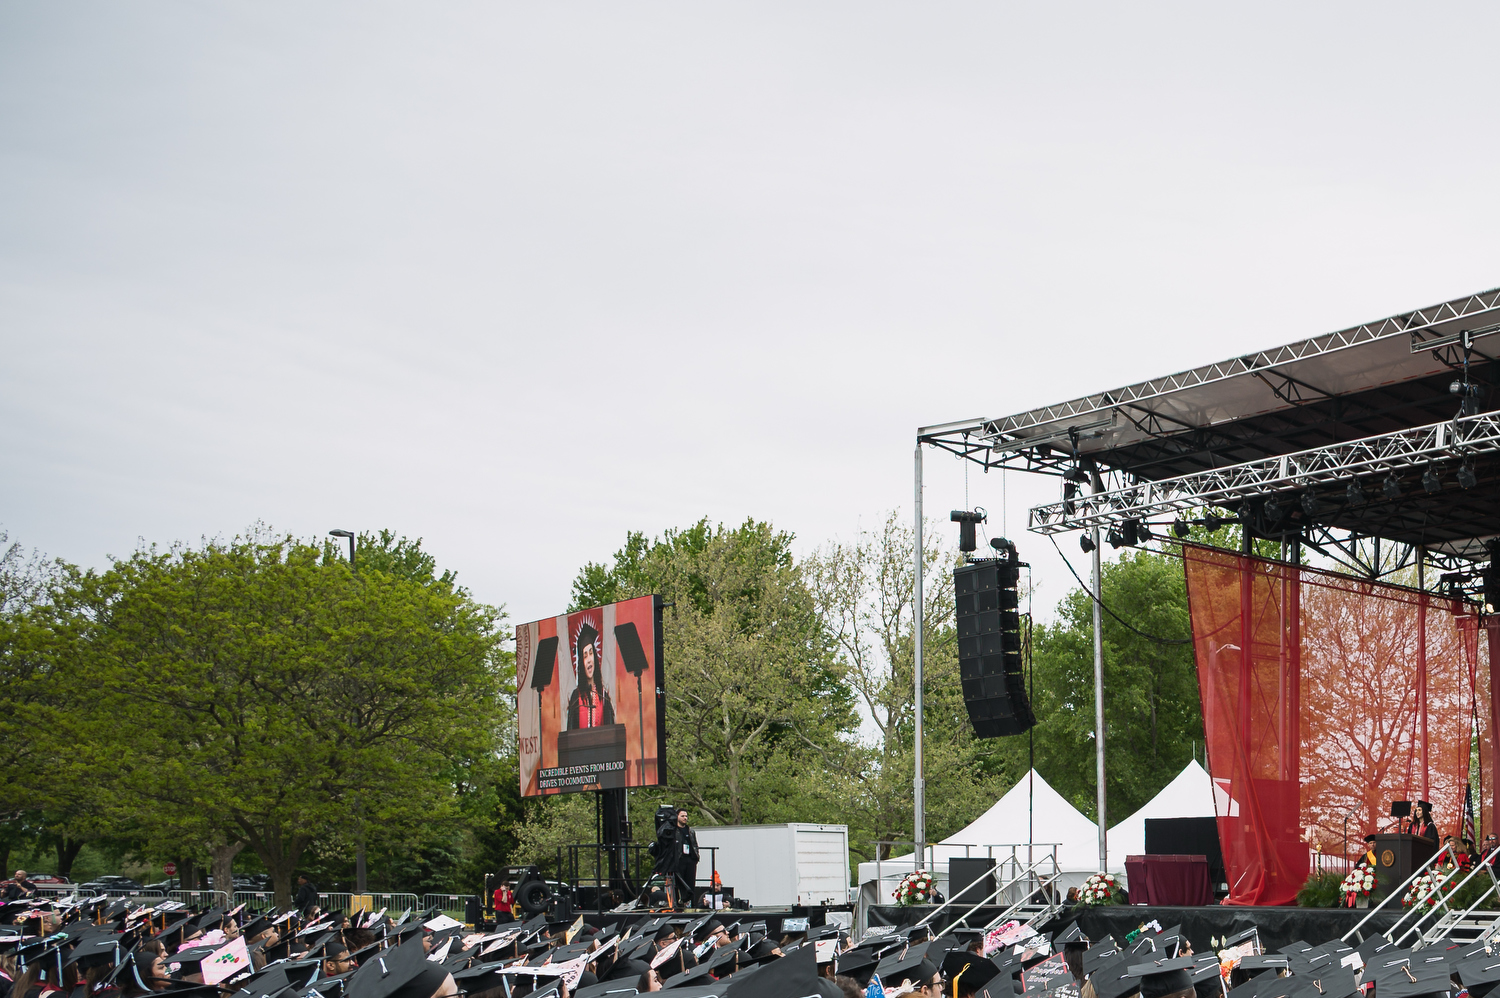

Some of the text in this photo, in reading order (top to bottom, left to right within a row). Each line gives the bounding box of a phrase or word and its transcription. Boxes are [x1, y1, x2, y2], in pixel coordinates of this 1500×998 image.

[540, 761, 624, 778] INCREDIBLE EVENTS FROM BLOOD
[540, 774, 597, 788] DRIVES TO COMMUNITY
